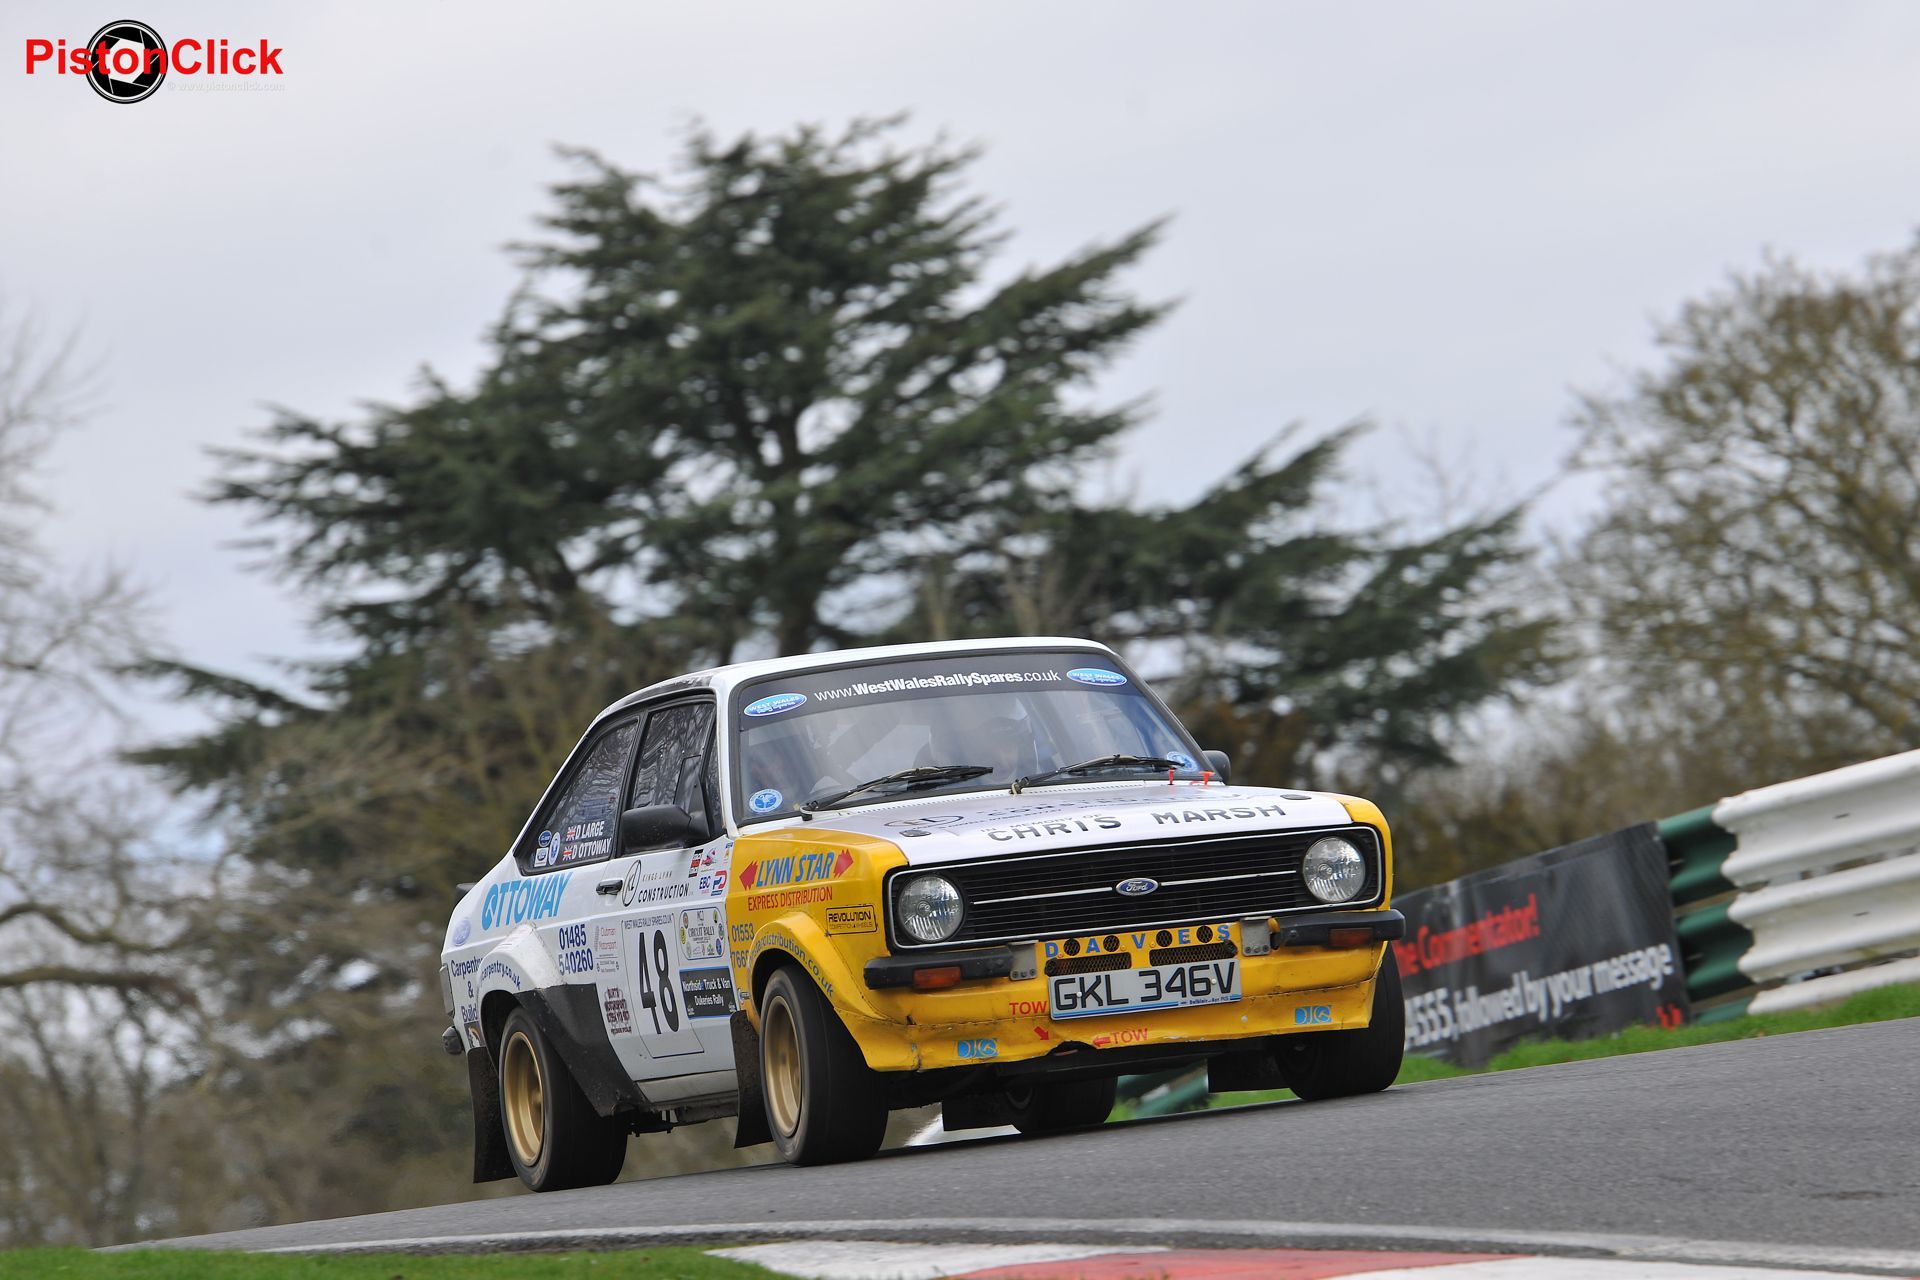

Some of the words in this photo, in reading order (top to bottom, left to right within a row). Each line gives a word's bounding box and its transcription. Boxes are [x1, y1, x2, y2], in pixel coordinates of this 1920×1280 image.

[814, 669, 1061, 701] www.WestWalesRallySpares.co.uk
[575, 828, 581, 841] D
[581, 821, 605, 840] LARGE
[988, 815, 1122, 842] CHRIS
[1151, 804, 1287, 825] MARSH
[571, 845, 578, 859] D
[578, 837, 612, 859] OTTOWAY
[756, 855, 795, 887] LYNN
[795, 852, 835, 882] STAR
[638, 883, 690, 903] CONSTRUCTION
[1126, 881, 1149, 892] Ford
[481, 872, 574, 931] OTTOWAY
[748, 893, 778, 911] EXPRESS
[780, 886, 833, 907] DISTRIBUTION
[828, 911, 872, 922] REVOLUTION
[559, 923, 587, 950] 01485
[732, 922, 755, 943] 01553
[1417, 892, 1540, 969] Commentator!
[558, 948, 594, 976] 540260
[467, 981, 475, 999] &
[639, 930, 680, 1035] 48
[682, 980, 705, 992] Northside
[704, 978, 716, 990] Truck
[721, 978, 732, 989] Van
[1054, 974, 1129, 1011] GKL
[1138, 961, 1235, 1003] 346V
[1454, 970, 1526, 1034] followed
[1521, 970, 1551, 1023] by
[1550, 964, 1595, 1018] your
[1592, 943, 1674, 993] message
[694, 995, 713, 1006] Dukeries
[713, 993, 725, 1007] Rally
[1009, 1001, 1047, 1016] TOW
[1110, 1028, 1148, 1045] TOW
